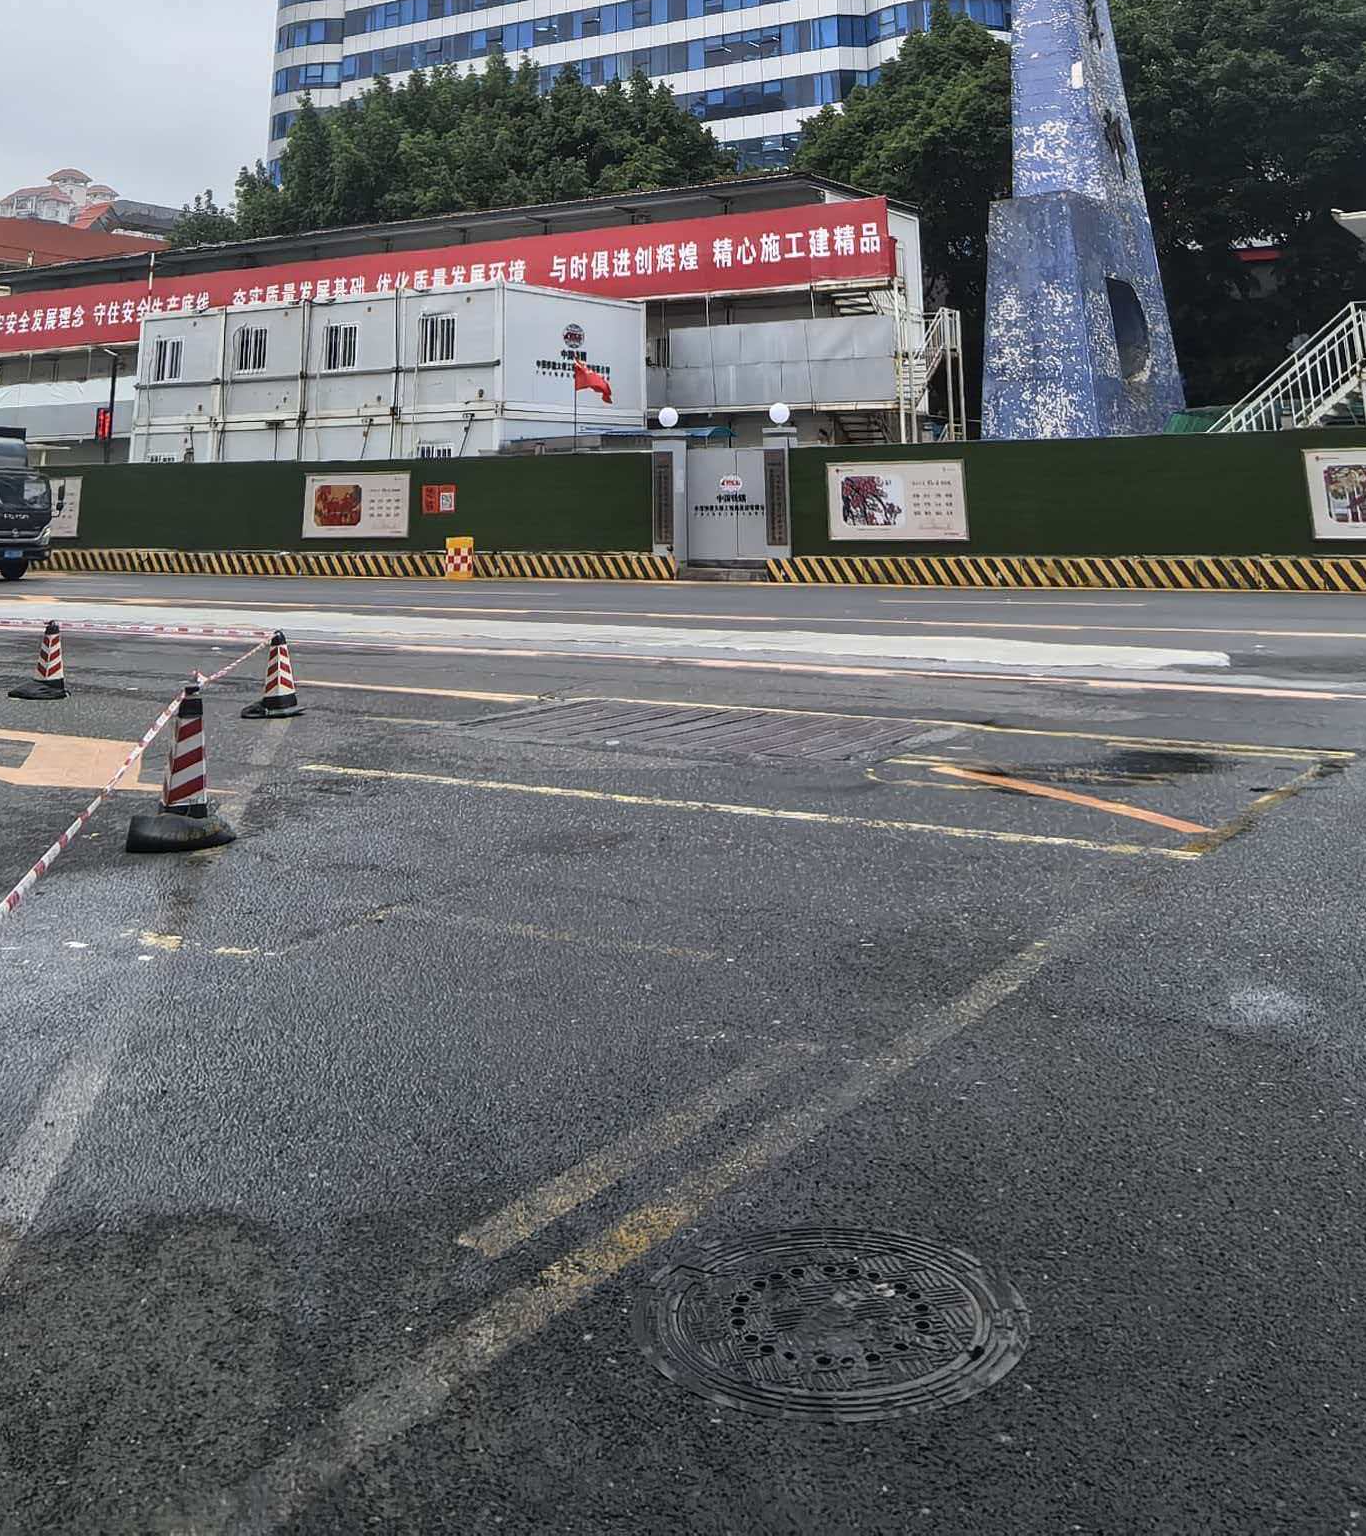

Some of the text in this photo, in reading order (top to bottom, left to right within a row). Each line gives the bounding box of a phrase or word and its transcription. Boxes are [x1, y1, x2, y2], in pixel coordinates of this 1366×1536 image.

[549, 240, 699, 284] 与时俱进创辉煌
[712, 222, 881, 270] 精心施工建精品
